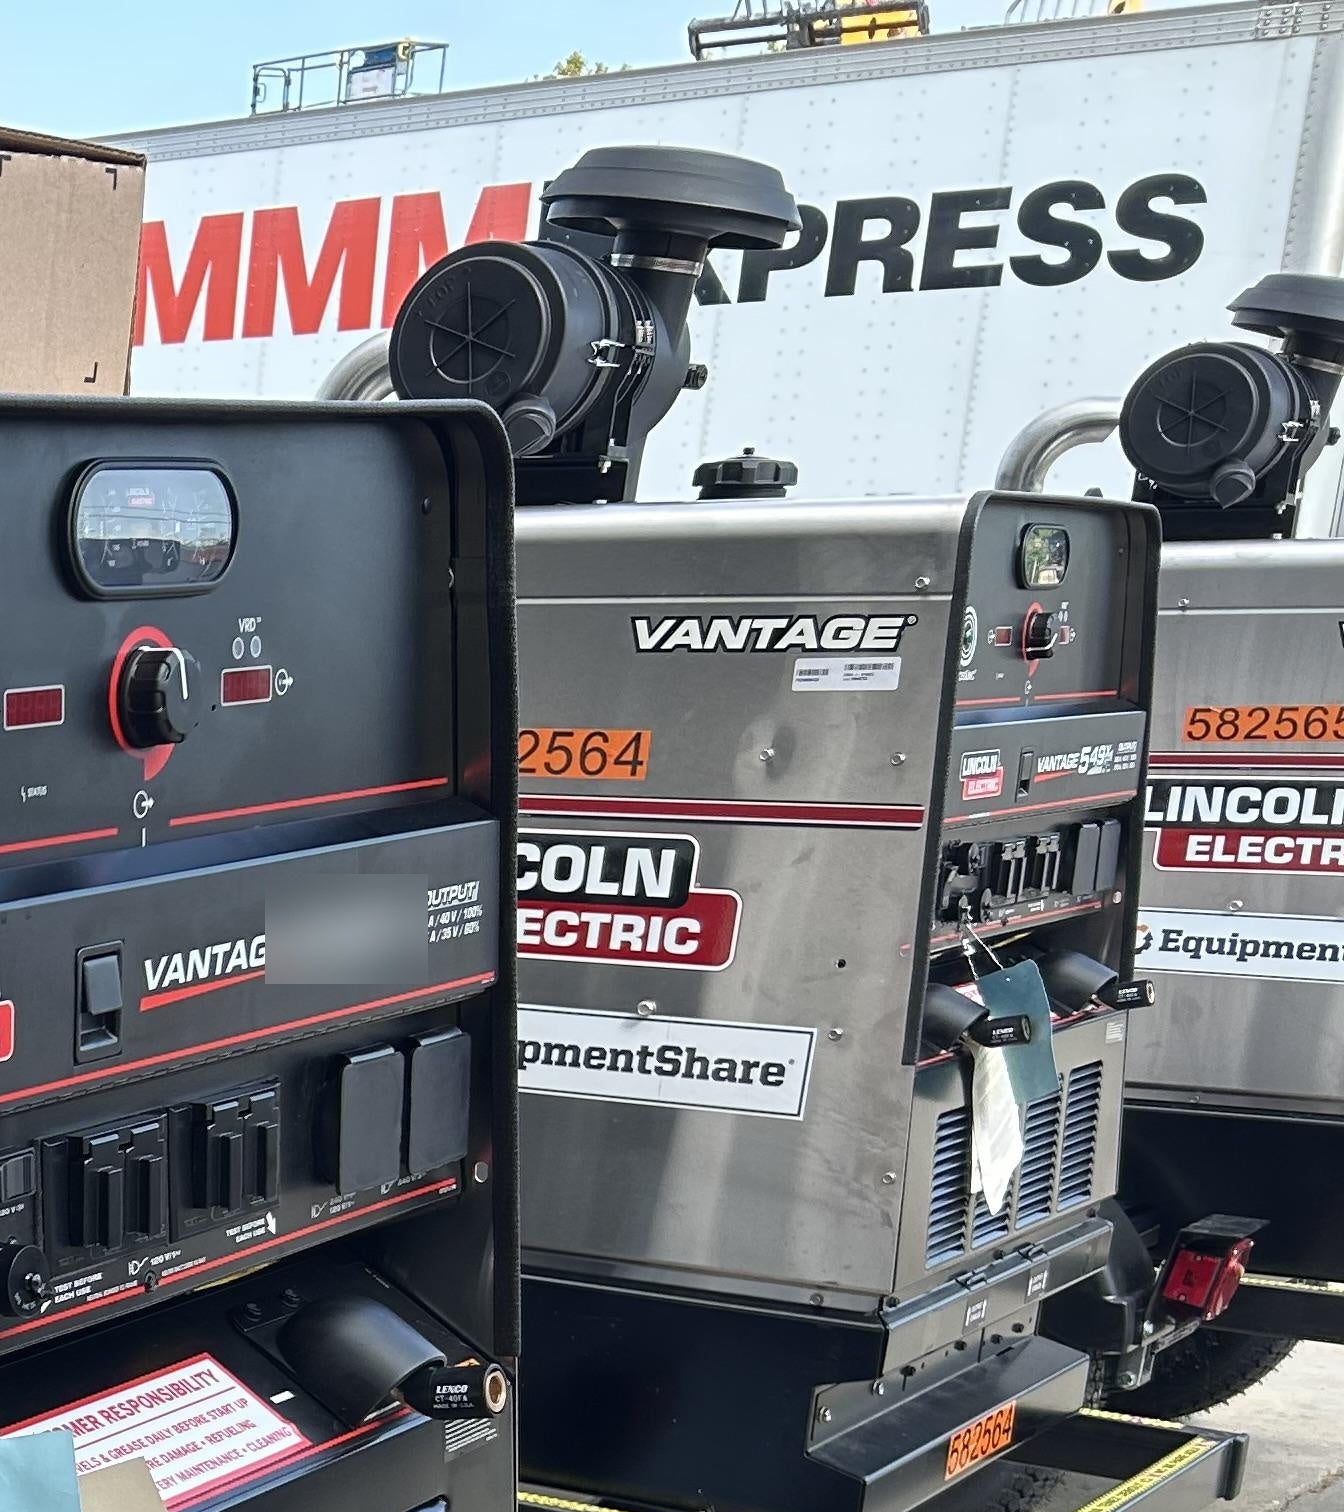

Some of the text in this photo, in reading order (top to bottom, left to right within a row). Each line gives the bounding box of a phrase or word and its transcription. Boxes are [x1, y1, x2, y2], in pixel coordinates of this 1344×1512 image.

[543, 174, 1206, 305] PRESS
[634, 616, 904, 651] VANTAGE
[518, 730, 644, 777] 2564
[517, 842, 676, 899] COLN
[1185, 834, 1344, 866] ELECTR
[517, 908, 701, 955] ECTRIC
[1158, 928, 1344, 963] Equipmen
[144, 932, 266, 992] VANTAG
[517, 1039, 786, 1087] pmentShare
[98, 1368, 221, 1425] RESPONSIBILITY
[435, 1384, 469, 1394] LENCO
[76, 1456, 101, 1474] VELS
[110, 1439, 146, 1460] GREASE
[145, 1427, 175, 1449] DAILY
[174, 1414, 211, 1435] BEFORE
[206, 1402, 235, 1423] START
[232, 1397, 249, 1411] UP
[157, 1418, 257, 1466] DAMAGE REFUELING
[175, 1426, 292, 1483] MAINTENANCE CLEANING
[949, 1407, 1014, 1474] 582564
